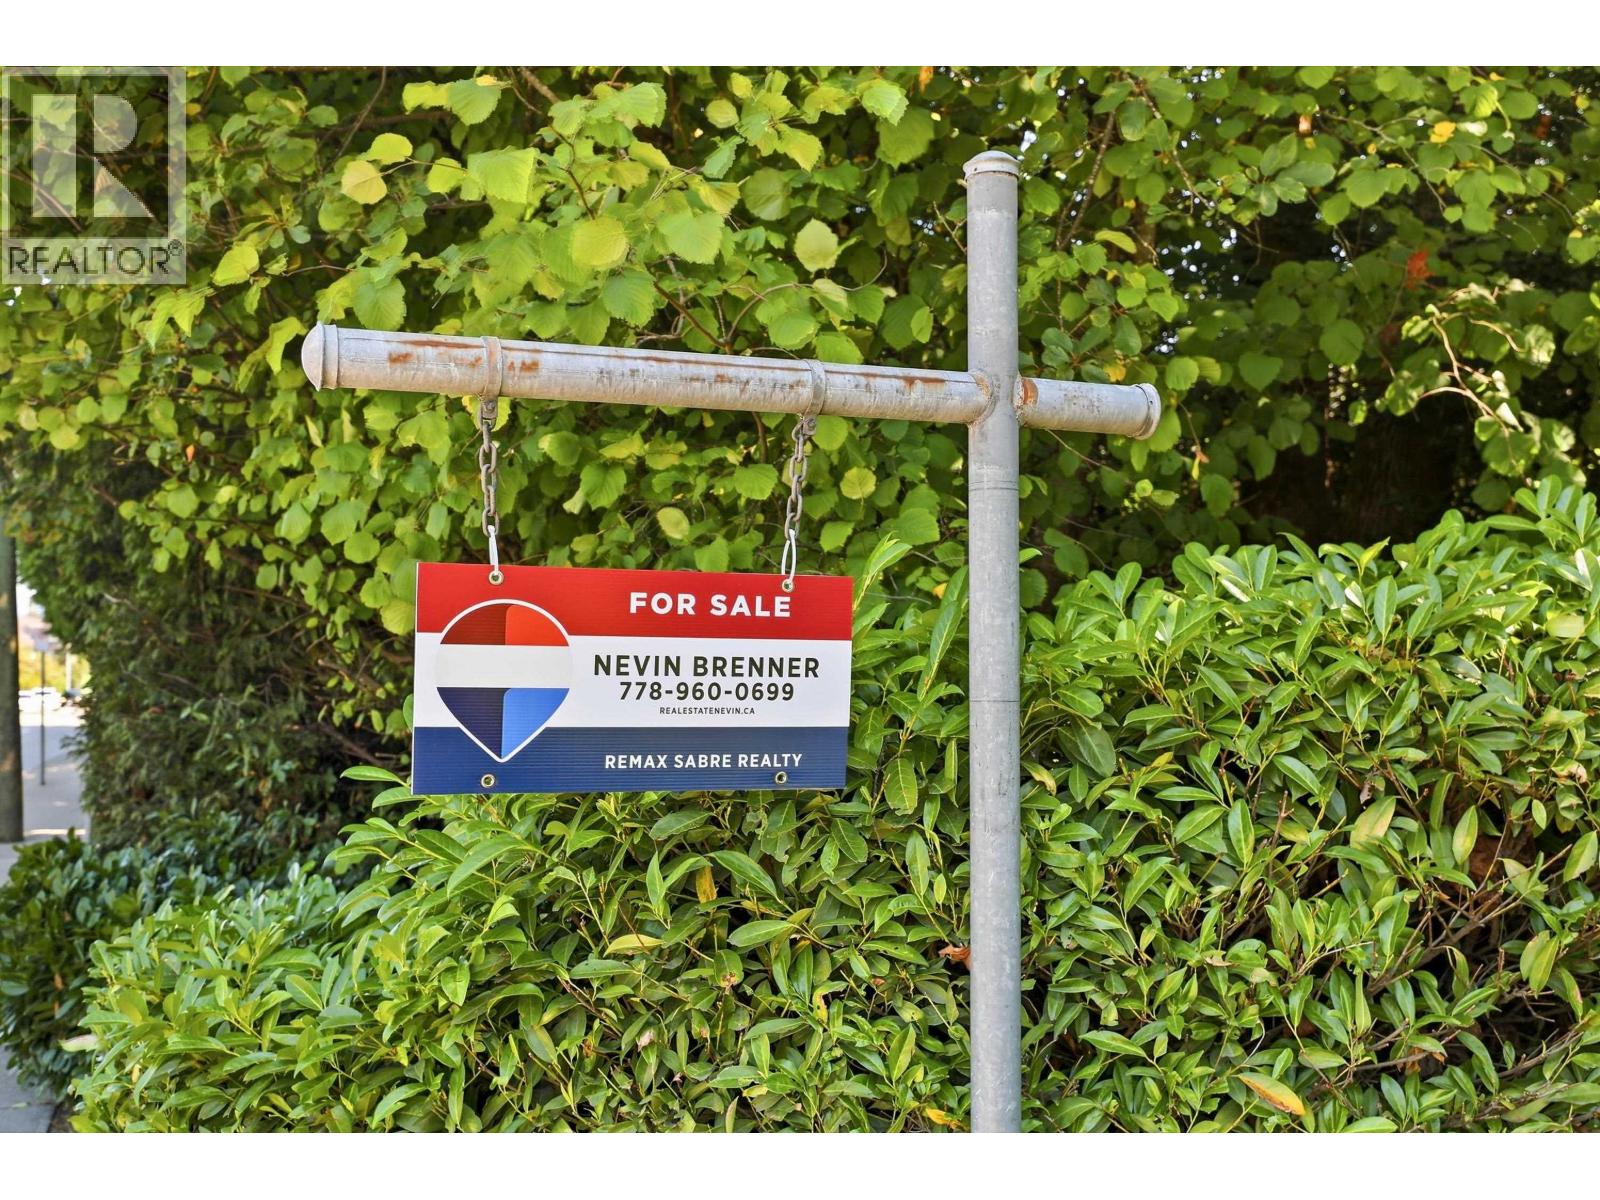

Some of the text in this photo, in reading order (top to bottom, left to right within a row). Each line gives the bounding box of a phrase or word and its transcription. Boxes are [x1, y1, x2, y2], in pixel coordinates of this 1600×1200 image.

[629, 592, 791, 617] FOR SALE
[593, 654, 820, 679] NEVIN BRENNER
[619, 682, 795, 701] 778-960-0699
[659, 707, 755, 715] REALESTATENEVIN.CA
[604, 753, 803, 769] REMAX SABRE REALTY
